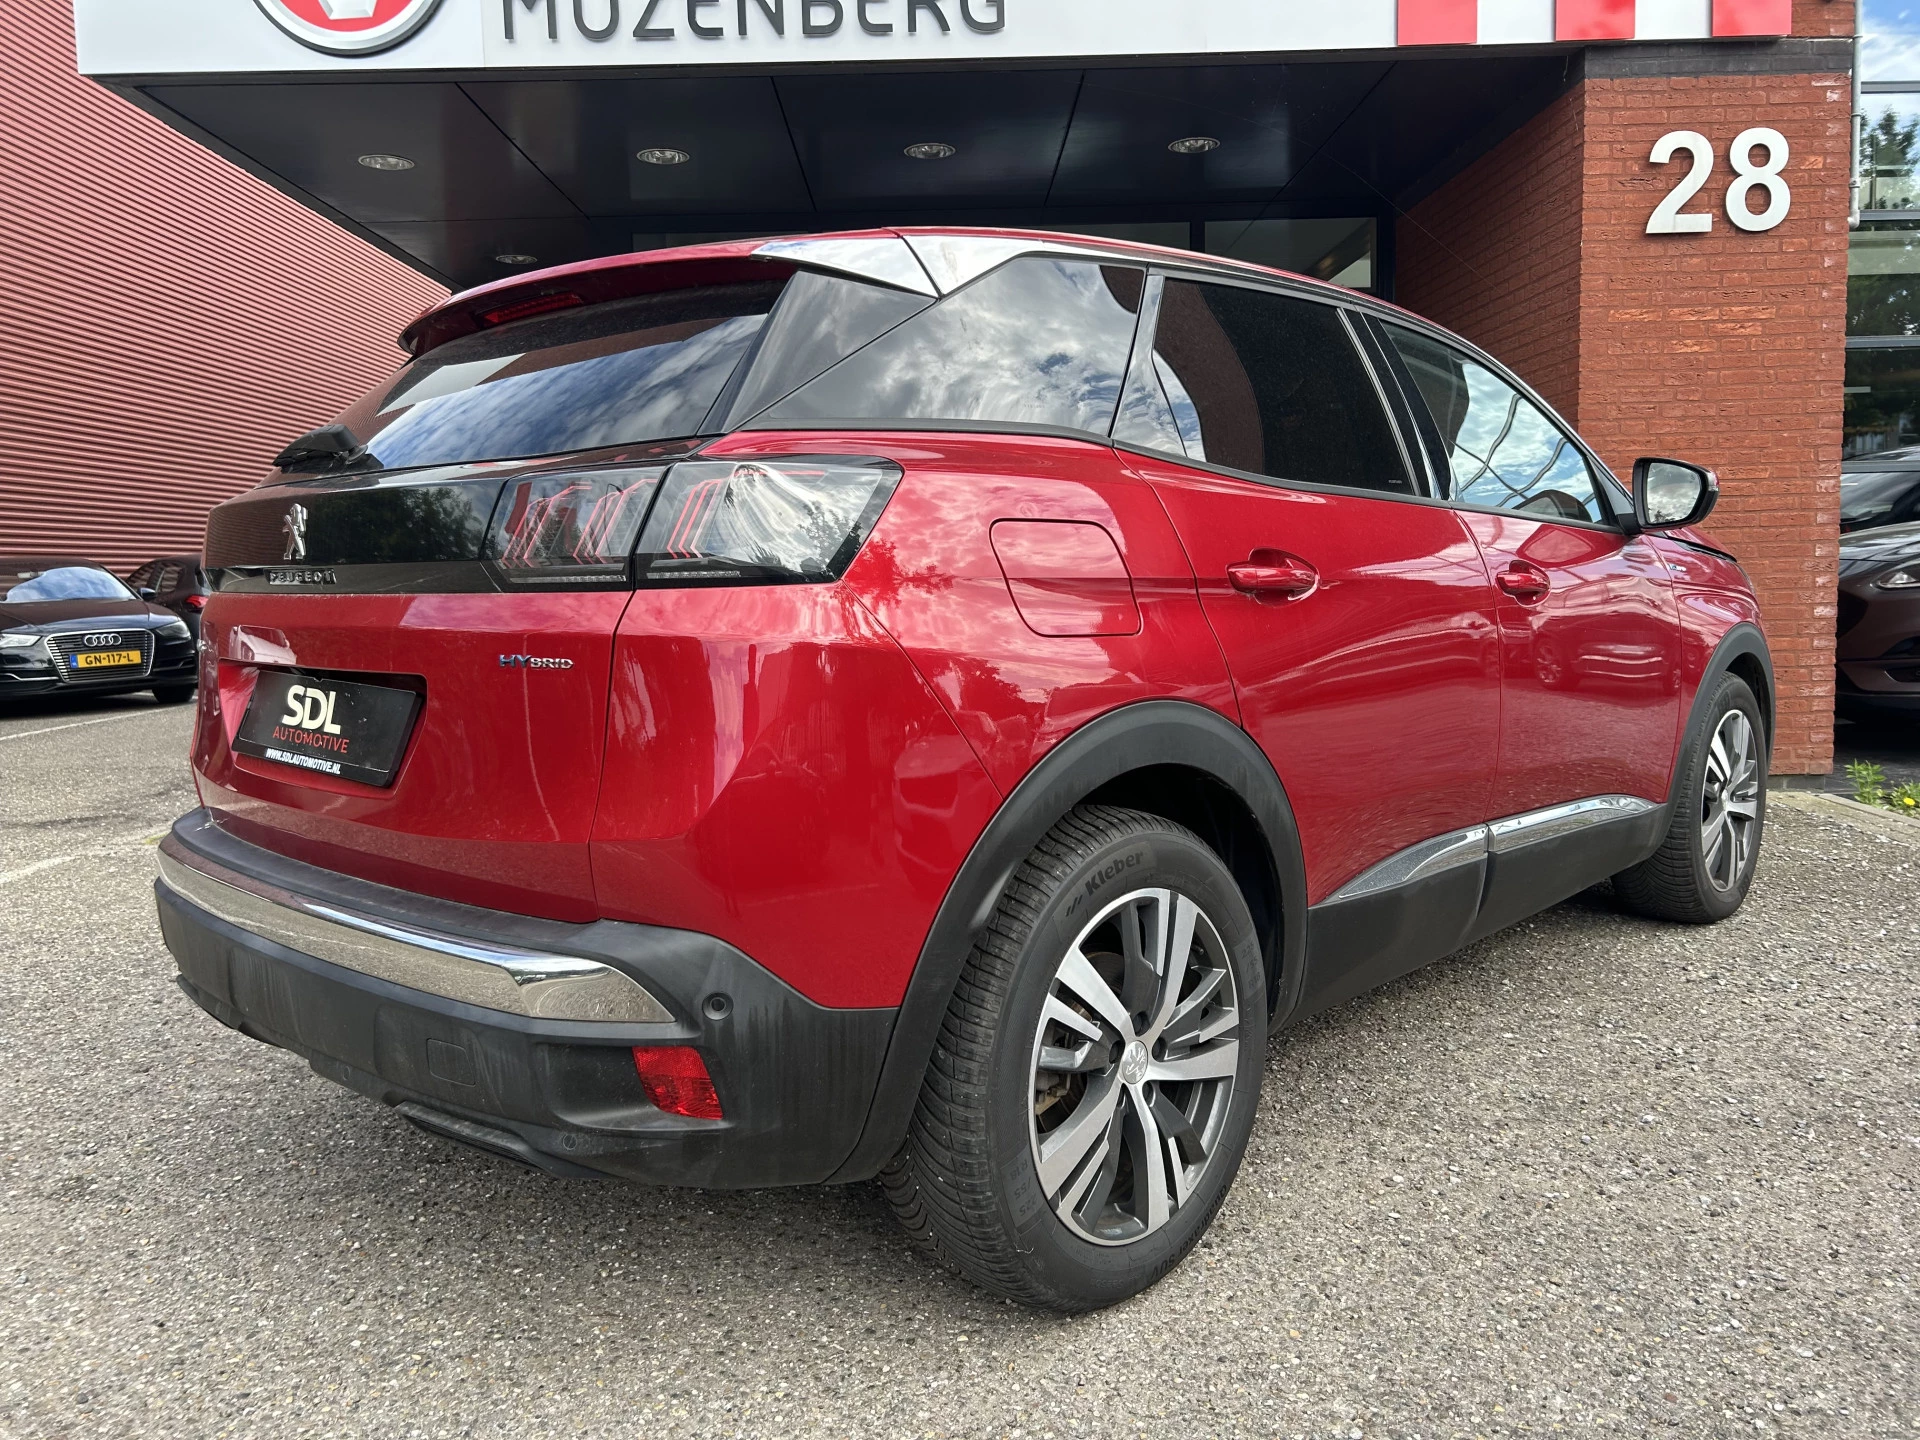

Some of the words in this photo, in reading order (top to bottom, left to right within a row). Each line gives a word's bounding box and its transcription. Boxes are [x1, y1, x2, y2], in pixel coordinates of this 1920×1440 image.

[1646, 127, 1791, 233] 28
[269, 570, 336, 583] PEUGEOT
[85, 653, 134, 665] GN-117-L
[499, 654, 574, 669] HYBRID
[281, 684, 341, 735] SDL
[272, 725, 350, 754] AUTOMOTIVE
[265, 747, 341, 775] WWW.SDLAUTOMOTIVE.NL
[1085, 851, 1144, 897] Kleber
